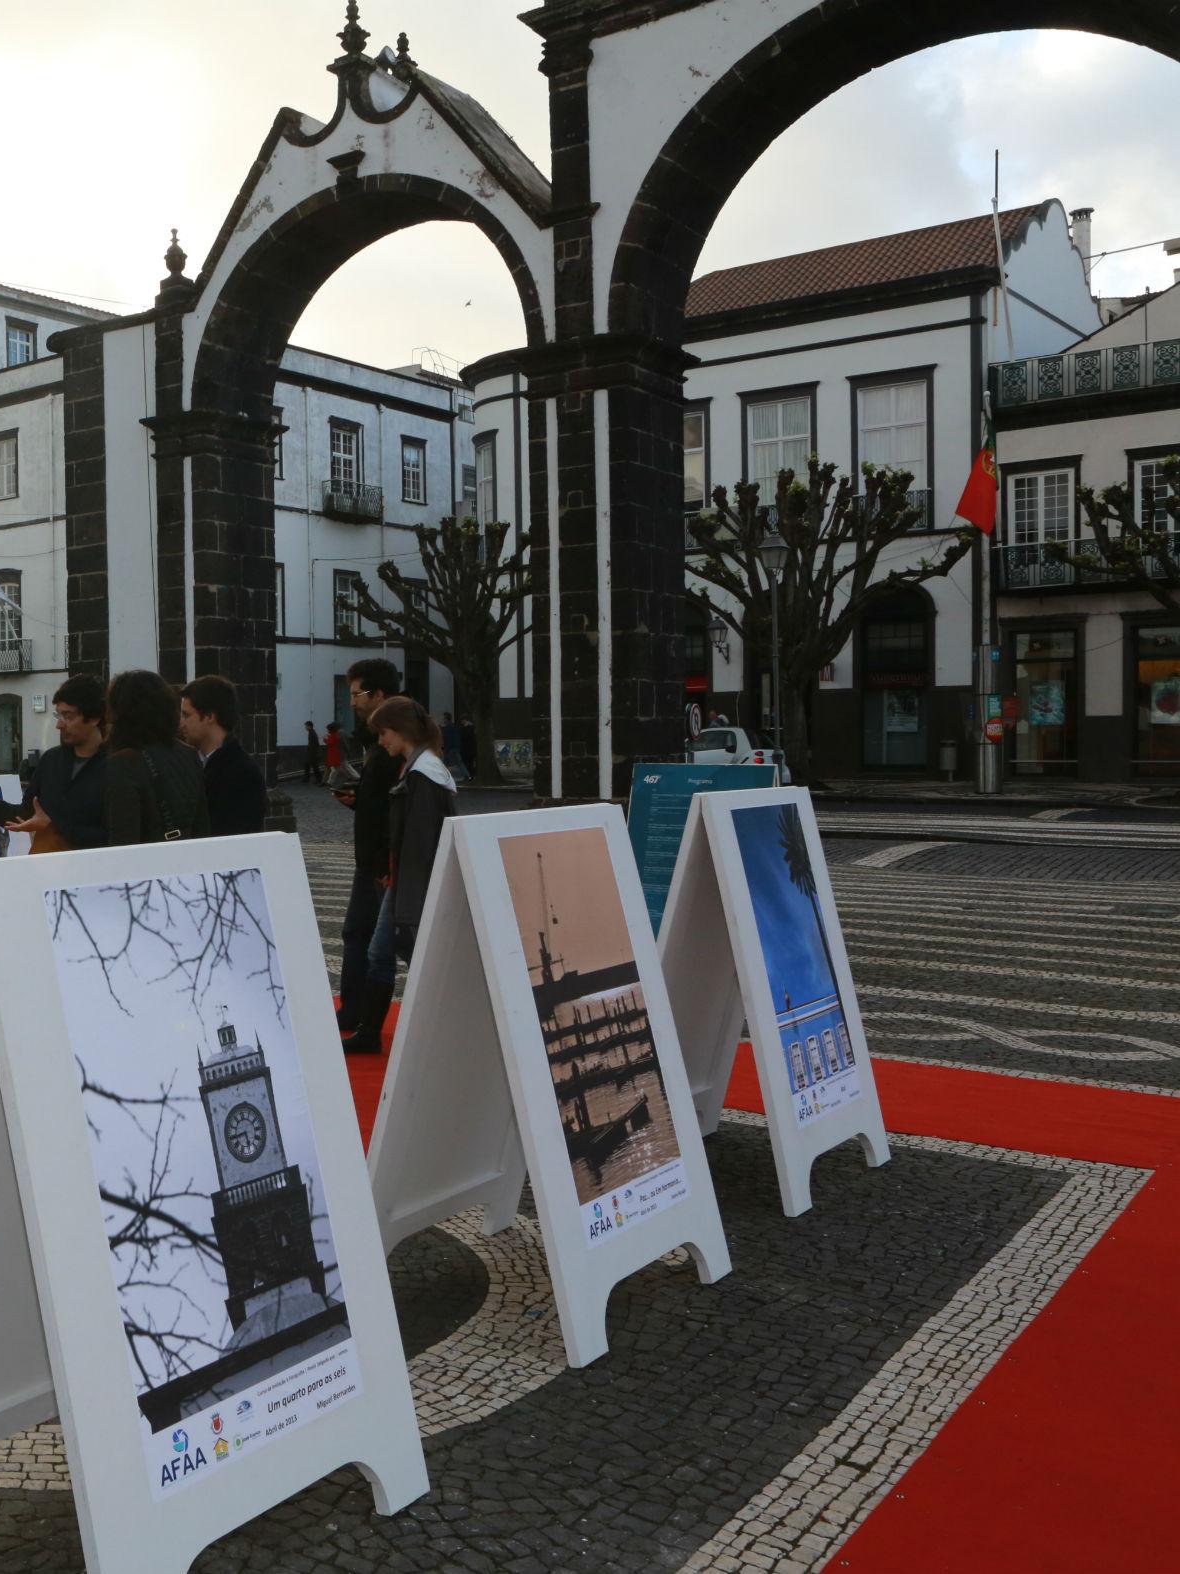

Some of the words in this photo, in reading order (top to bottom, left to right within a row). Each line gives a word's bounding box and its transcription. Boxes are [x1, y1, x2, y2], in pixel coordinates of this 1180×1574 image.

[798, 1105, 814, 1122] AFAA
[589, 1216, 613, 1240] AFAA
[267, 1401, 281, 1413] Um
[281, 1389, 306, 1407] quarto
[307, 1379, 324, 1398] para
[324, 1374, 333, 1384] as
[333, 1365, 347, 1380] seis
[316, 1395, 333, 1410] Miguel
[333, 1384, 356, 1401] Bernardes
[265, 1423, 278, 1437] Abril
[278, 1420, 286, 1432] de
[285, 1414, 298, 1428] 2013
[160, 1447, 208, 1487] AFAA
